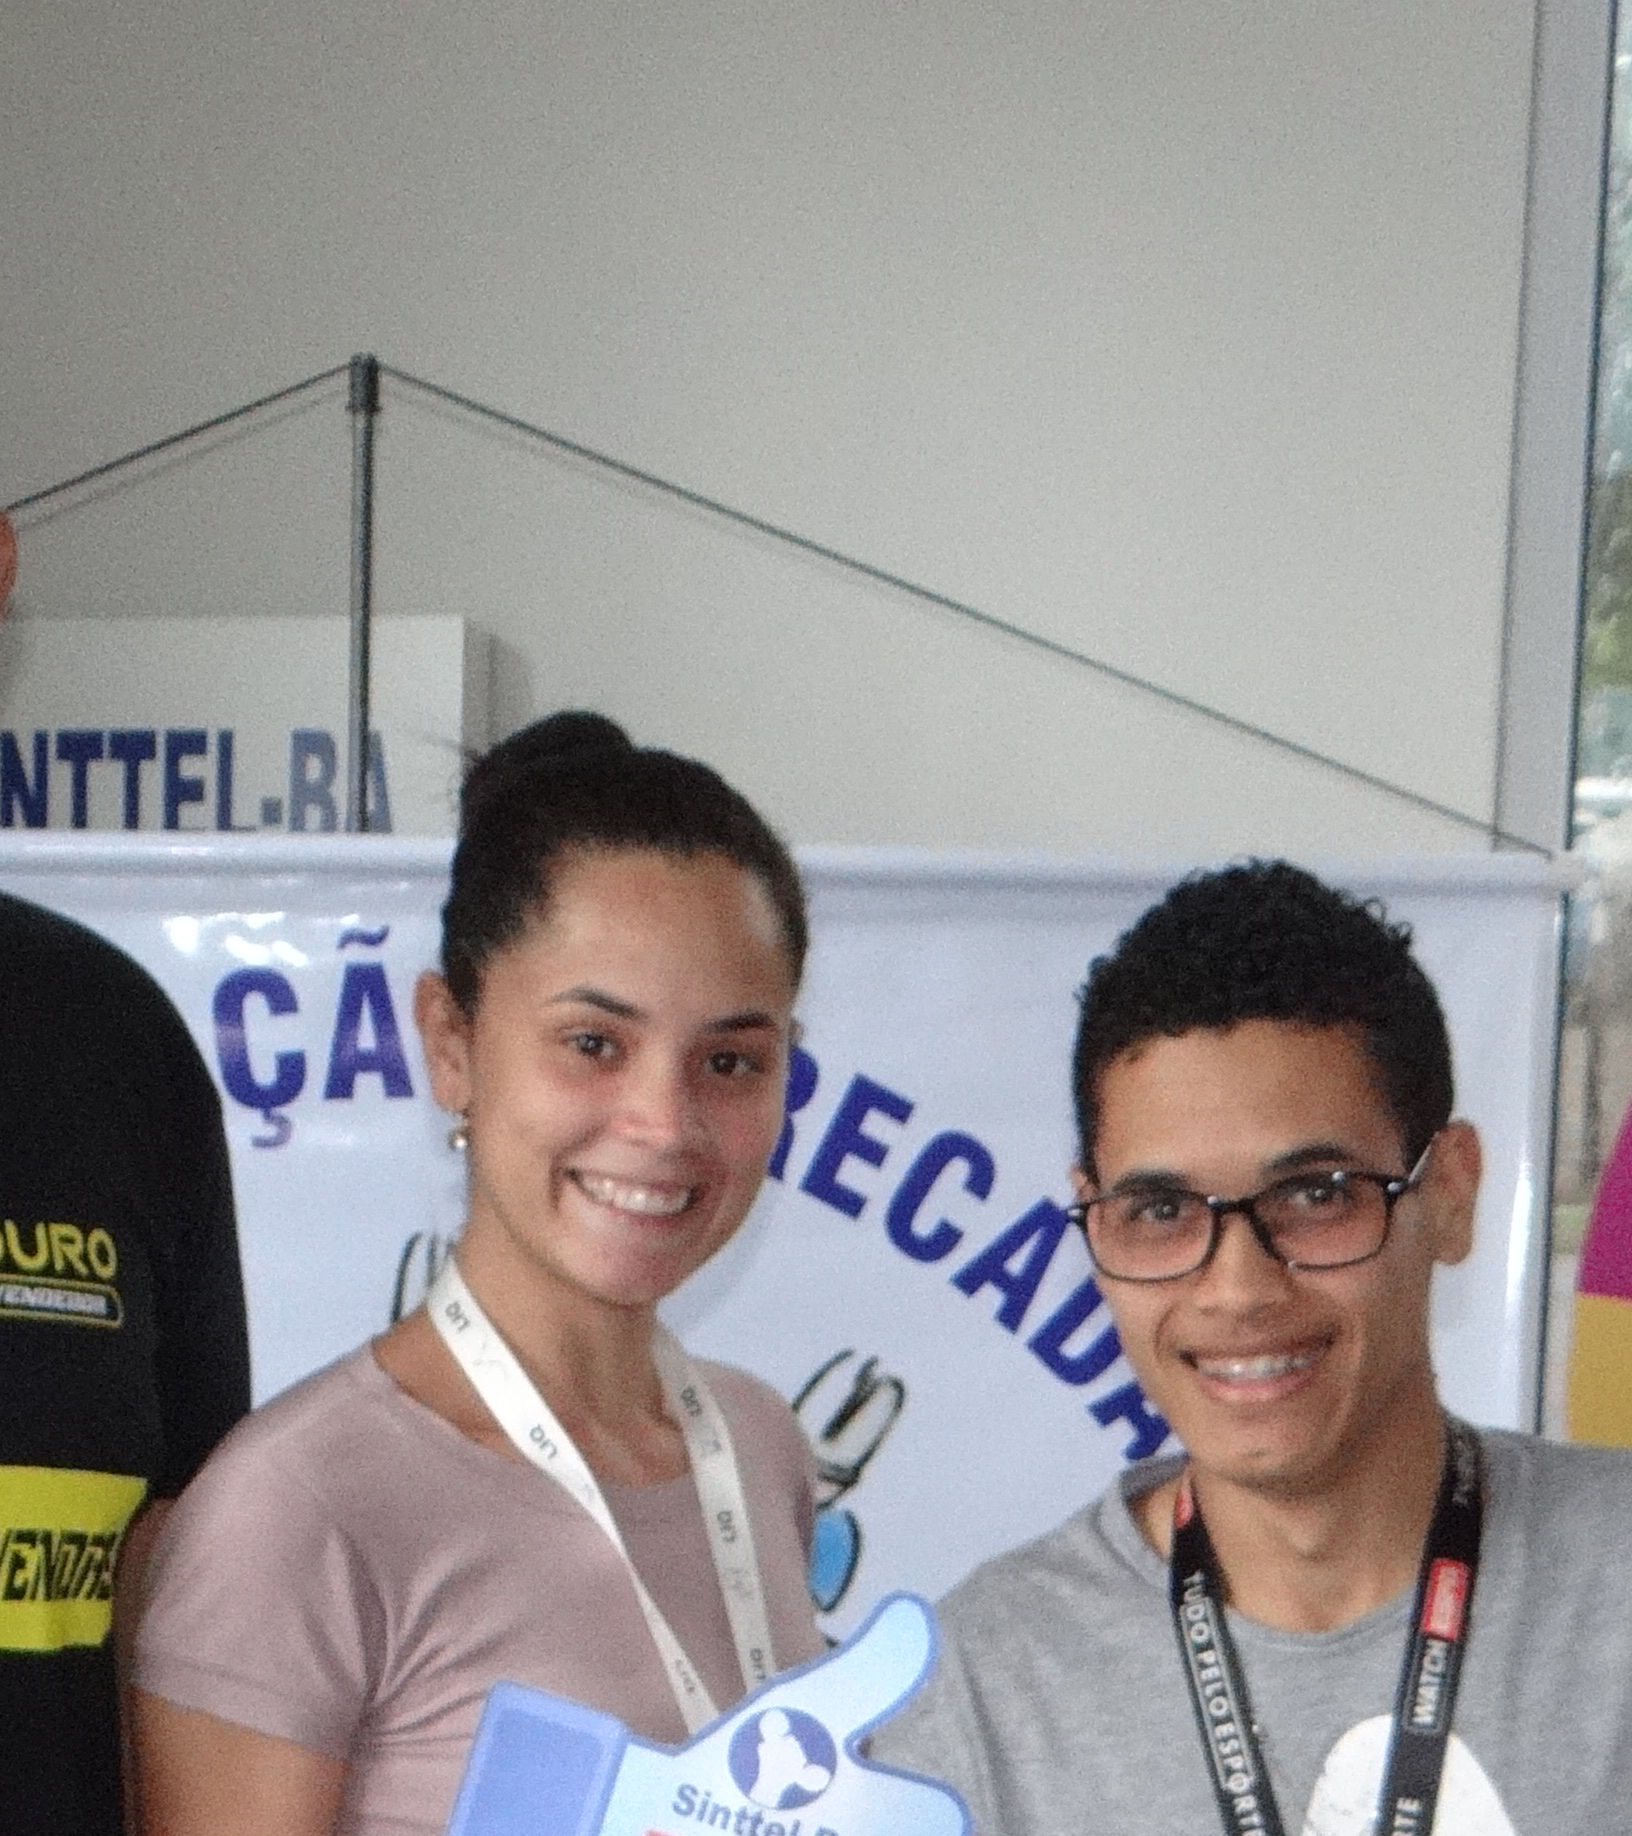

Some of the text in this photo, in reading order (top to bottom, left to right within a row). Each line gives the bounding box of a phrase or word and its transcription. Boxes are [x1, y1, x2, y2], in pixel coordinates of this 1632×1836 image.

[1181, 1569, 1210, 1645] TUDO
[1197, 1649, 1231, 1718] PELO
[1412, 1638, 1448, 1729] WATCH
